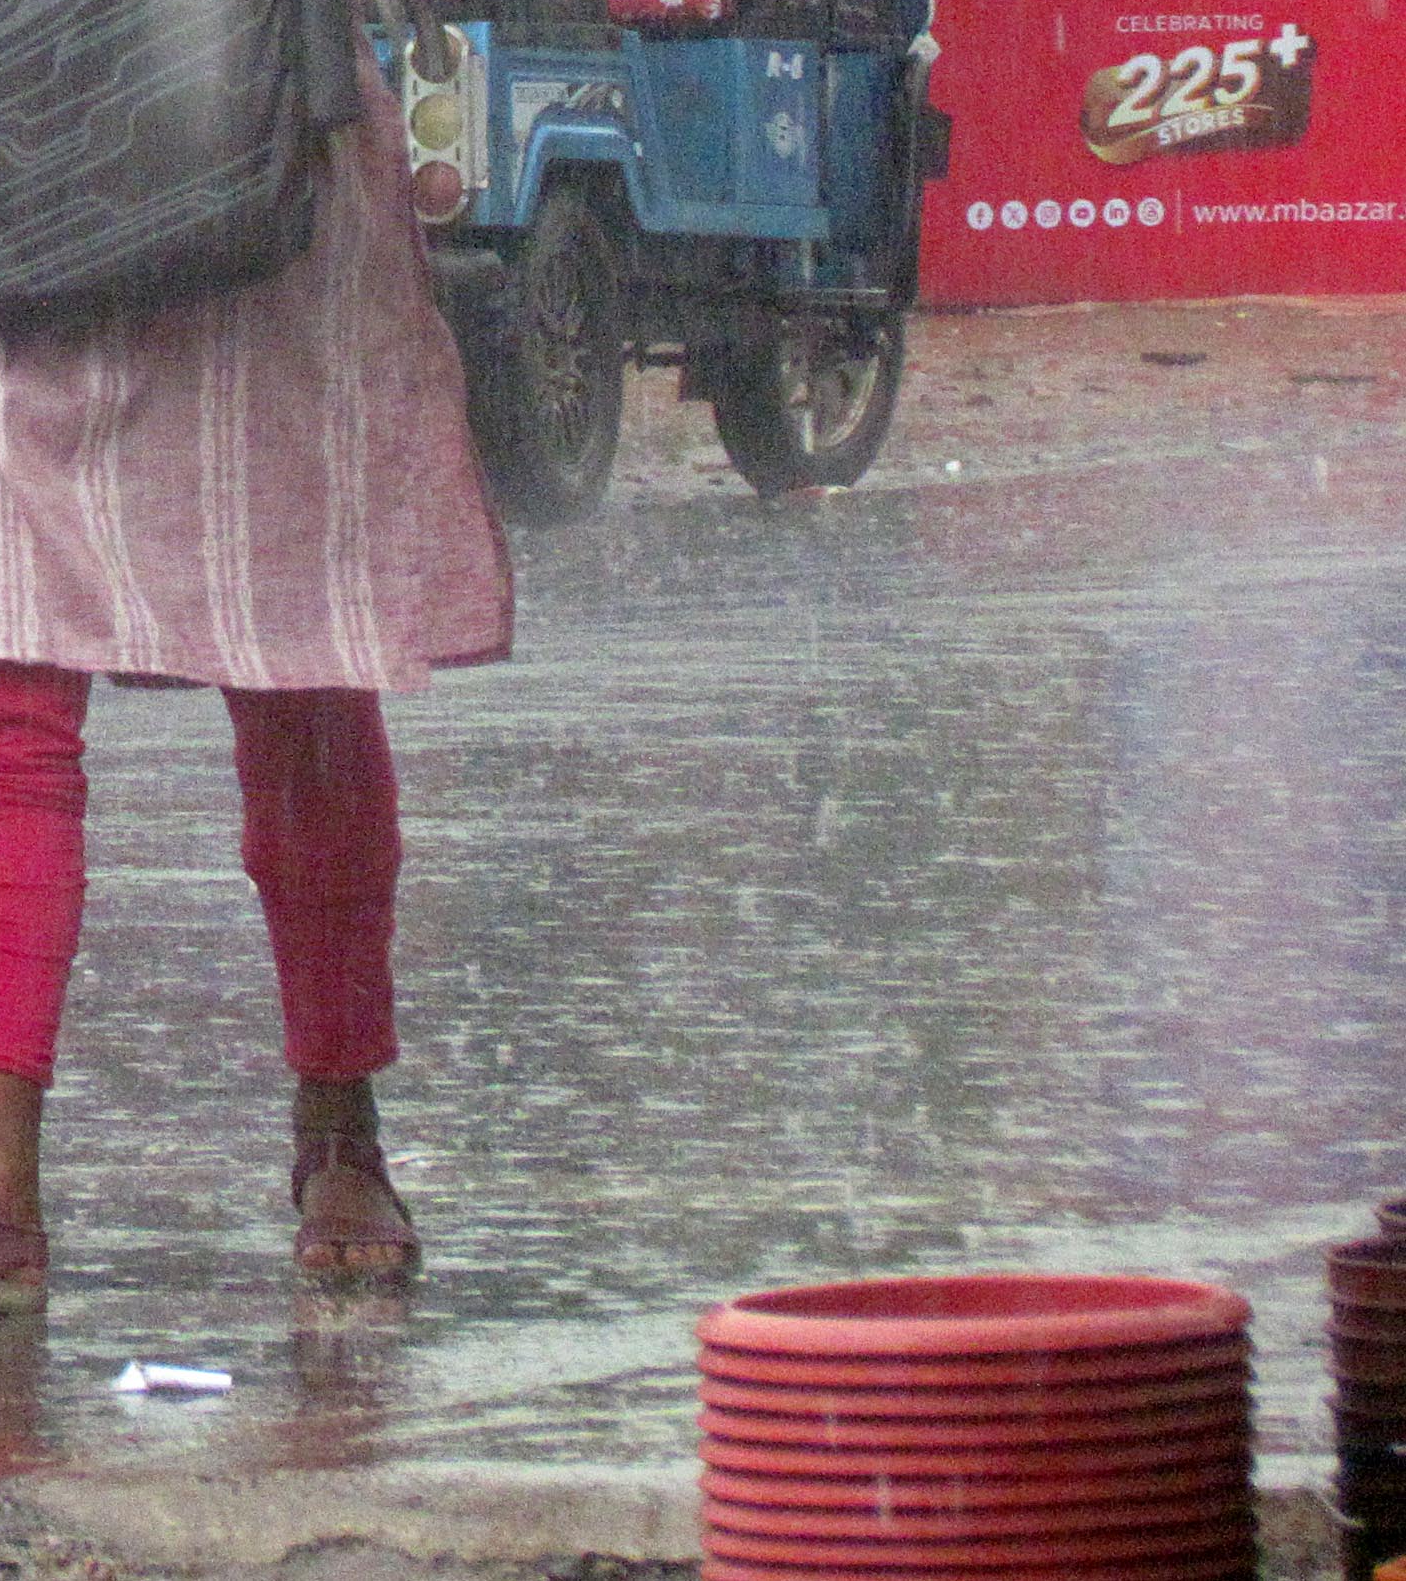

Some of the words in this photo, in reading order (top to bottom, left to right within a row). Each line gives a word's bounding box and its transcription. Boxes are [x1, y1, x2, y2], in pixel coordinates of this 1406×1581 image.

[1116, 14, 1265, 33] CELEBRATING
[1157, 108, 1247, 146] STORES
[1192, 199, 1406, 224] www.mbaazar.
